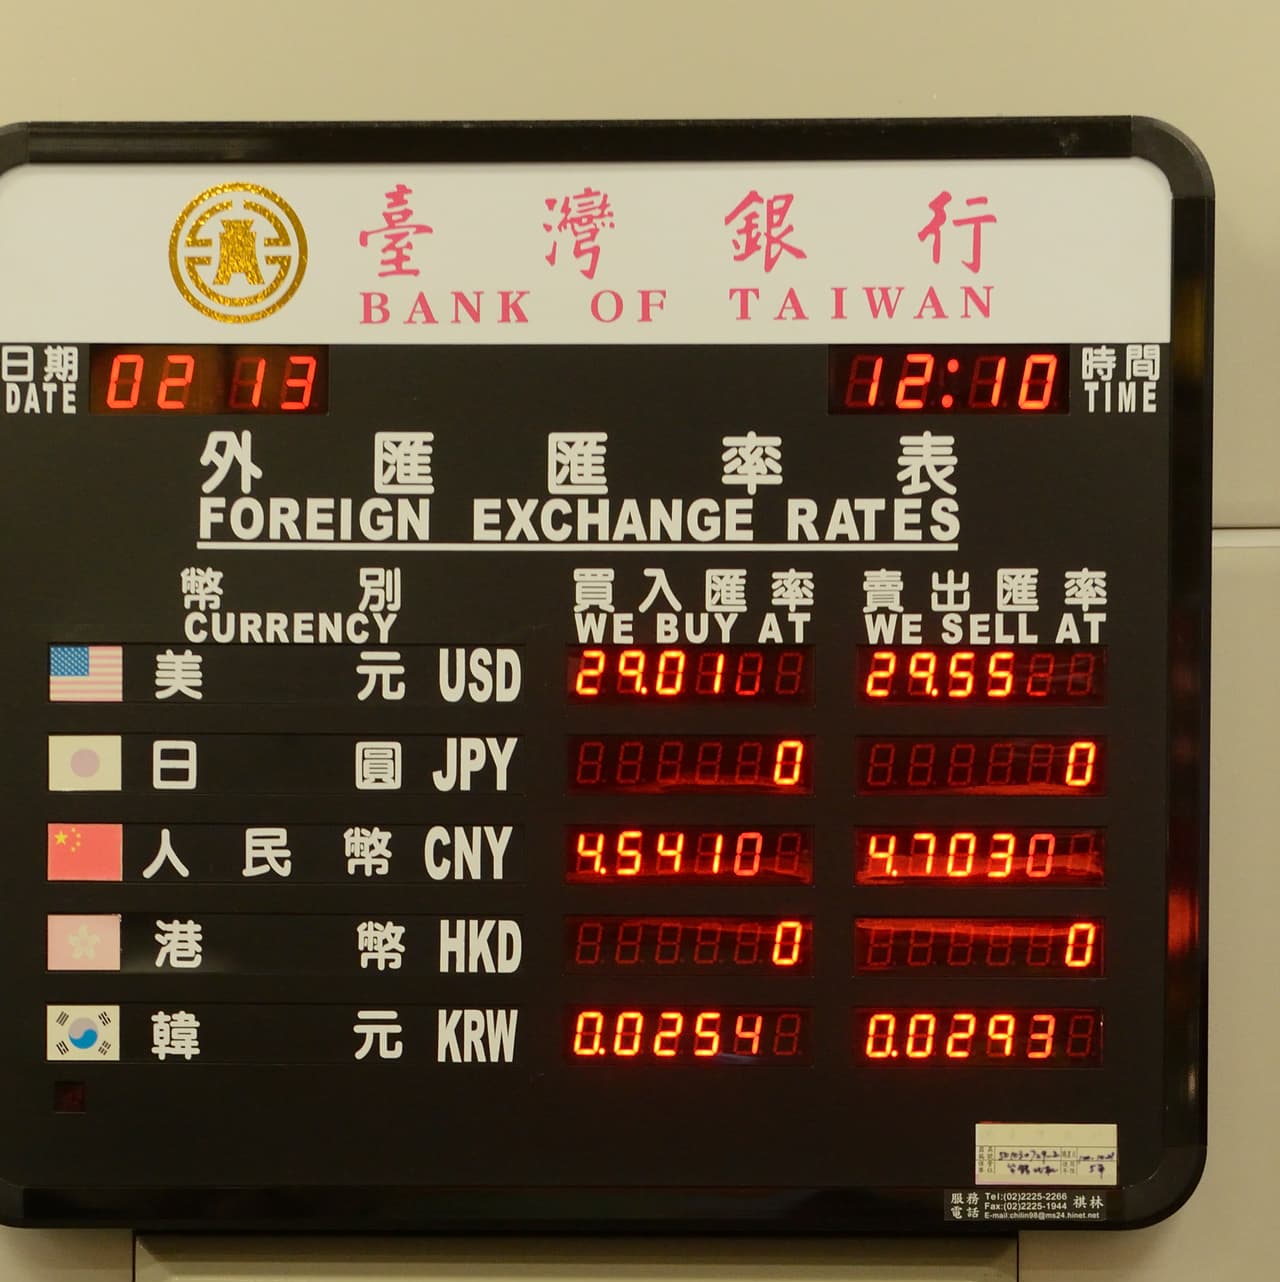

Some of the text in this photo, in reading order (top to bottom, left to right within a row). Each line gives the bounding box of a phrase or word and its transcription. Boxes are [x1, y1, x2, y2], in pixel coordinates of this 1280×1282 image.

[359, 184, 996, 280] 臺灣銀行
[359, 286, 995, 325] BANK OF TAIWAN
[1, 345, 78, 383] 日期
[106, 354, 318, 410] 02 13
[867, 354, 1058, 410] 12:10
[1081, 344, 1160, 381] 時間
[6, 383, 76, 414] DATE
[1085, 382, 1157, 413] TIME
[200, 430, 959, 498] 外匯匯率表
[200, 497, 961, 542] FOREIGN EXCHANGE RATES
[180, 567, 402, 612] 幣別
[573, 567, 815, 613] 買入匯率
[863, 567, 1108, 613] 賣出匯率
[184, 611, 398, 644] CURRENCY
[575, 613, 812, 644] WE BUY AT
[864, 613, 1108, 644] WE SELL AT
[155, 648, 521, 702] 美元 USD
[152, 737, 518, 791] 日圓 JPY
[143, 826, 513, 881] 人民幣 CNY
[577, 831, 763, 876] 4.5410
[868, 833, 1055, 878] 4.7030
[155, 919, 522, 974] 港幣 HKD
[151, 1009, 518, 1063] 韓元 KRW
[573, 1012, 763, 1057] 0.0254
[865, 1014, 1055, 1058] 0.0293
